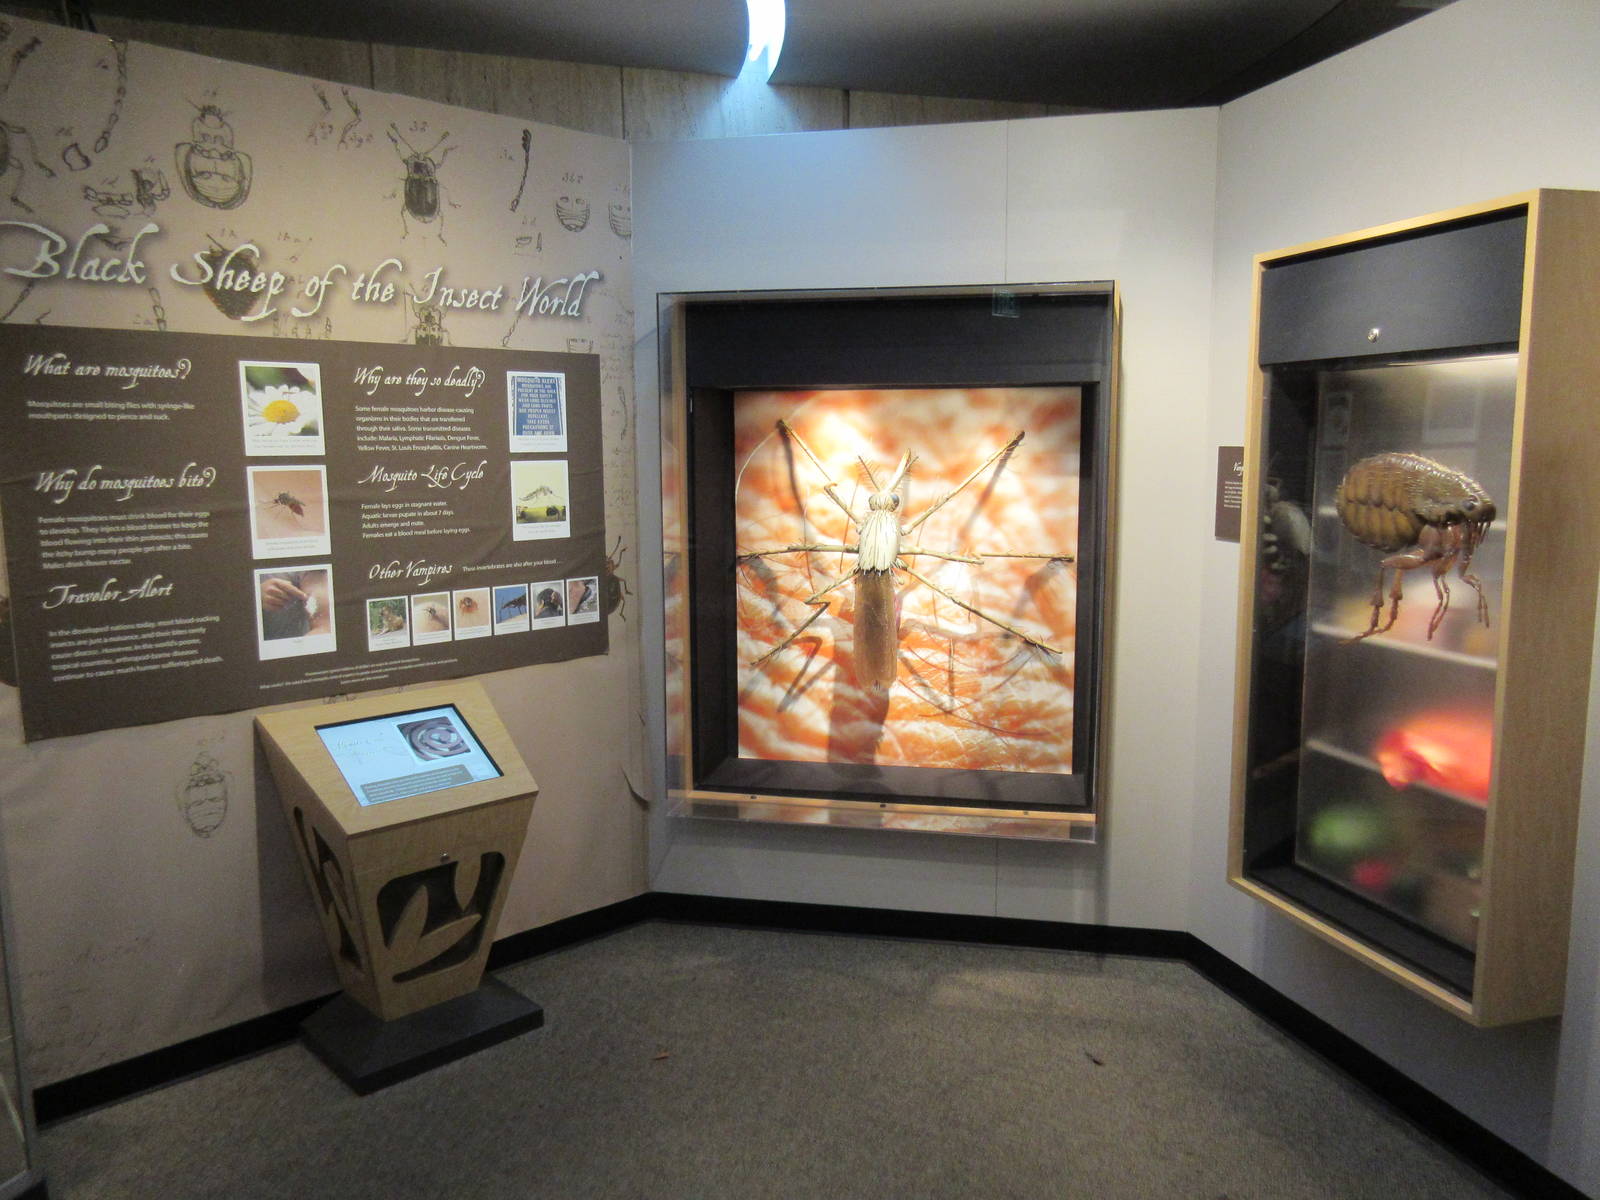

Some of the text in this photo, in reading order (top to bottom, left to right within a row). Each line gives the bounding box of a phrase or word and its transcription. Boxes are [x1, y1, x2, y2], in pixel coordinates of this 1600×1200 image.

[0, 221, 600, 321] Black Sheep of the Insect World
[22, 351, 193, 391] What are mosquitoes?
[354, 366, 485, 397] Why are they so deadly?
[35, 462, 216, 504] Why do mosquitoes bite?
[358, 460, 487, 492] Mosquito Life Cycle
[361, 512, 381, 520] Aquatic
[362, 531, 383, 540] Females
[398, 530, 413, 538] blood
[414, 529, 425, 537] meal
[427, 528, 442, 536] before
[443, 527, 457, 535] laying
[369, 559, 453, 586] Other Vampires
[42, 575, 174, 609] Traveler Alert
